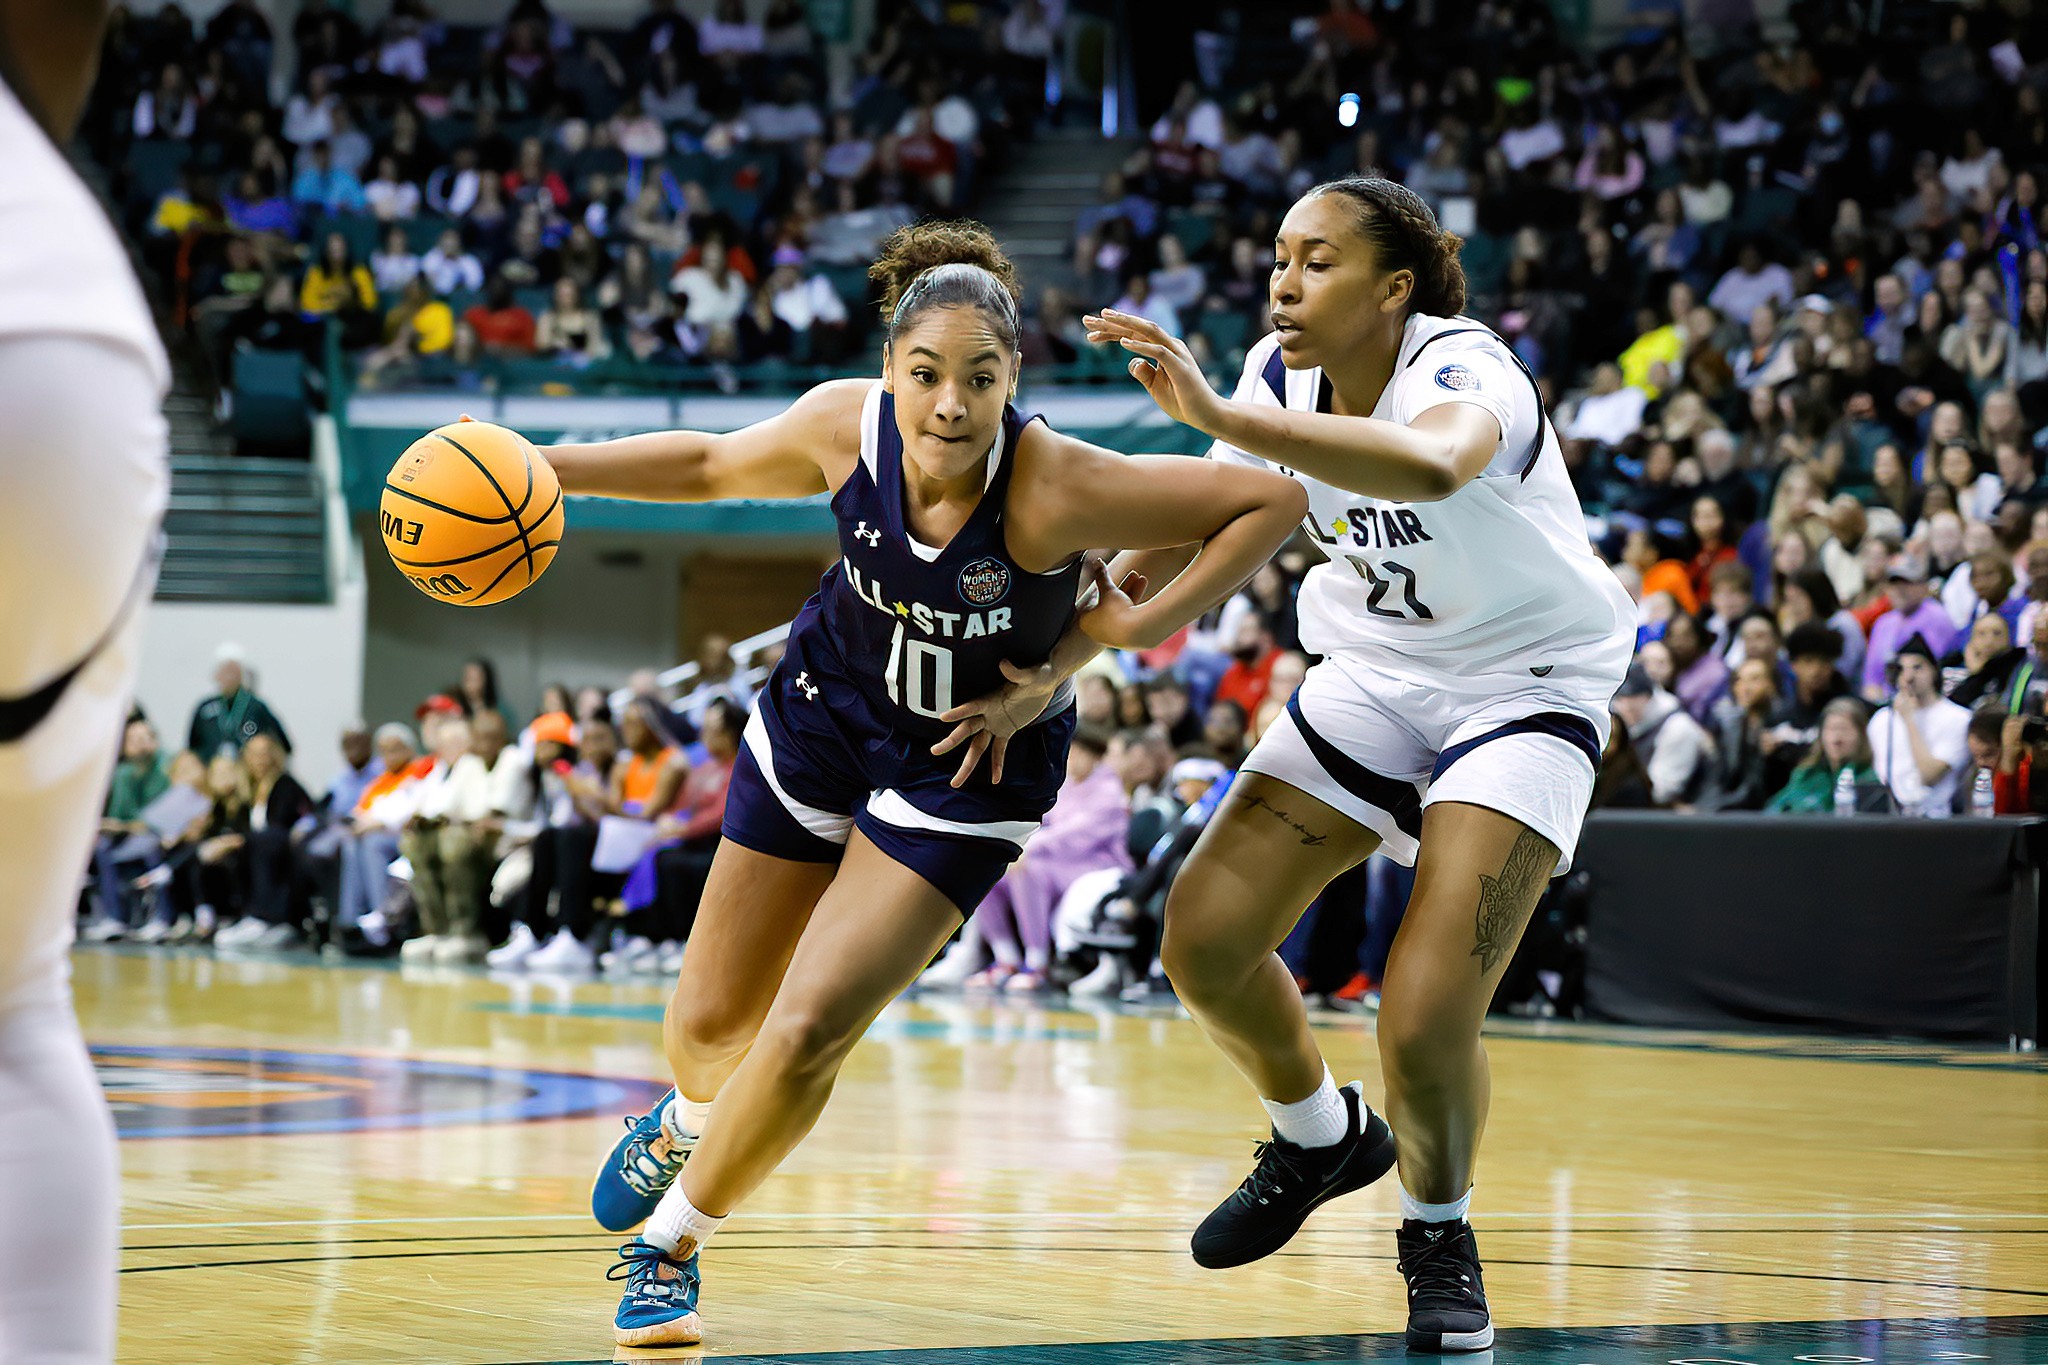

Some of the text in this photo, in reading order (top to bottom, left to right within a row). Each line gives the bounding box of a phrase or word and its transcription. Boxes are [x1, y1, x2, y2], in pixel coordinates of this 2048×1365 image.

[1346, 507, 1433, 549] STAR
[962, 569, 1007, 585] WOMEN'S
[911, 601, 1013, 640] STAR
[884, 620, 953, 720] 10
